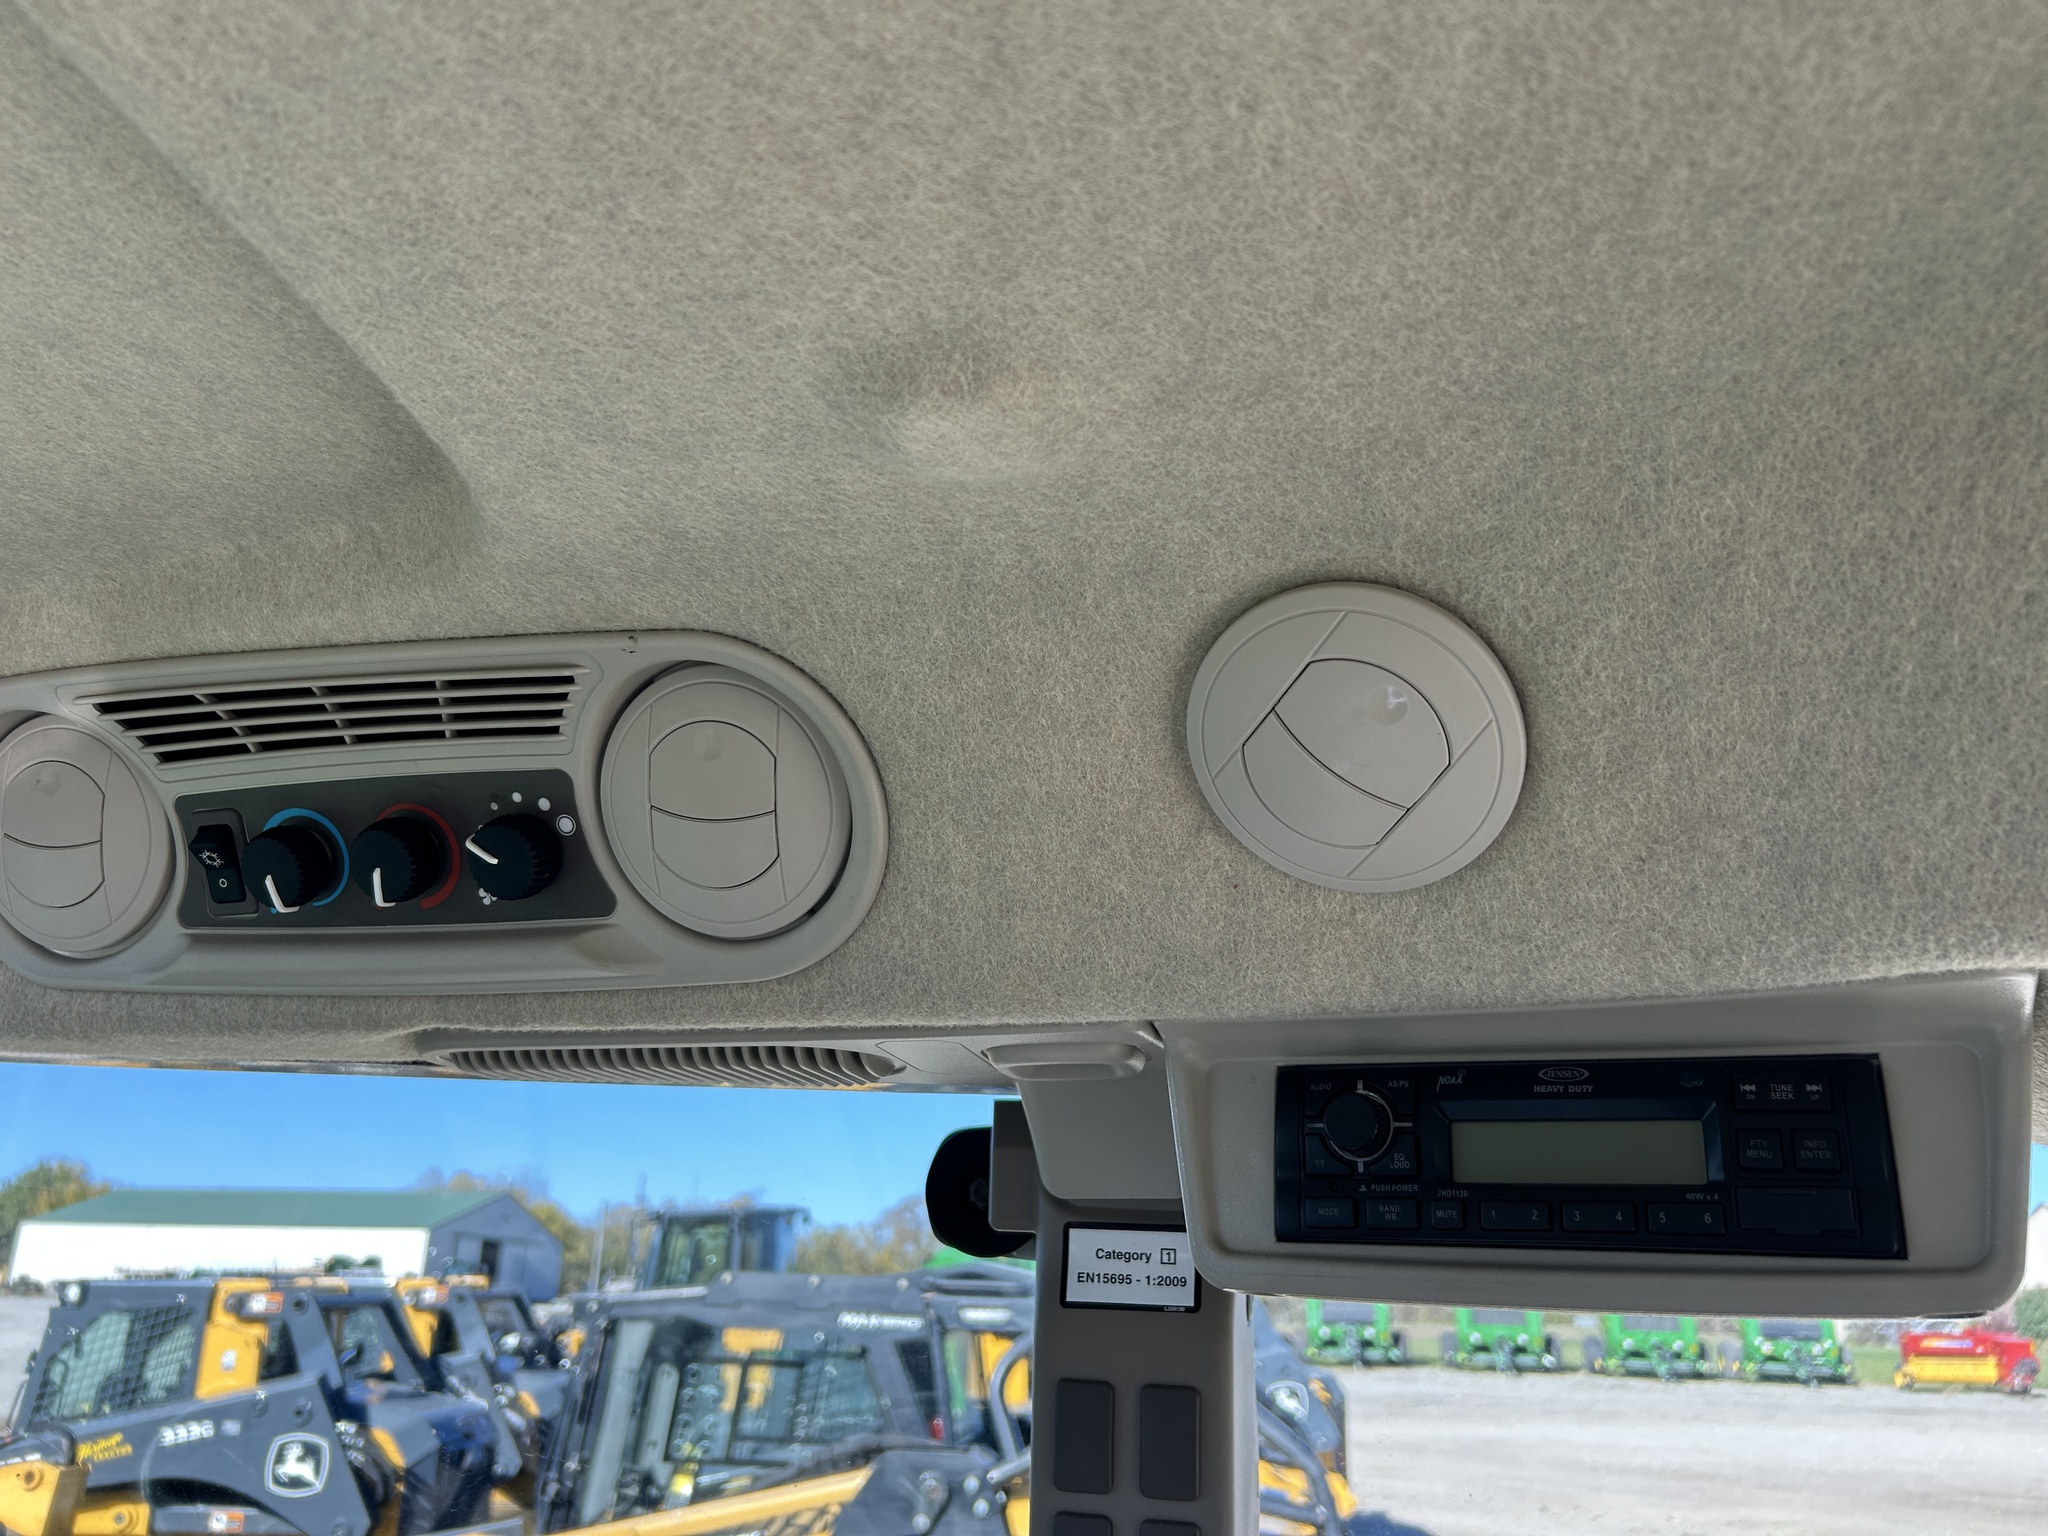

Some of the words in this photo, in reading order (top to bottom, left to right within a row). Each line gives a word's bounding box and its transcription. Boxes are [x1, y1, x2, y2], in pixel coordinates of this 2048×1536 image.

[1544, 1069, 1582, 1078] JENSEN
[1309, 1082, 1332, 1091] AUDIO
[1387, 1079, 1410, 1088] AS/PS
[1436, 1072, 1464, 1093] NOAA
[1533, 1084, 1565, 1093] HEAVY
[1568, 1084, 1594, 1093] DUTY
[1768, 1083, 1794, 1092] TUNE
[1769, 1091, 1795, 1100] SEEK
[1749, 1139, 1768, 1148] PTY
[1804, 1139, 1827, 1148] INFO
[1393, 1152, 1405, 1162] EQ
[1746, 1149, 1773, 1159] MENU
[1800, 1150, 1832, 1160] ENTER
[1389, 1160, 1410, 1169] LOUD
[1370, 1183, 1391, 1192] PUSH
[1391, 1183, 1419, 1192] POWER
[1436, 1189, 1468, 1198] JHD1130
[1685, 1192, 1704, 1201] 40W
[1713, 1192, 1719, 1201] 4
[1317, 1207, 1339, 1216] MODE
[1436, 1209, 1458, 1219] MUTE
[1490, 1209, 1497, 1220] 1
[1531, 1209, 1539, 1221] 2
[1573, 1210, 1581, 1222] 3
[1384, 1212, 1397, 1221] WB
[1615, 1211, 1623, 1222] 4
[1659, 1212, 1666, 1223] 5
[1704, 1212, 1712, 1224] 6
[1095, 1248, 1152, 1263] Category
[1077, 1272, 1133, 1285] EN15695
[1145, 1275, 1187, 1287] 1:2009
